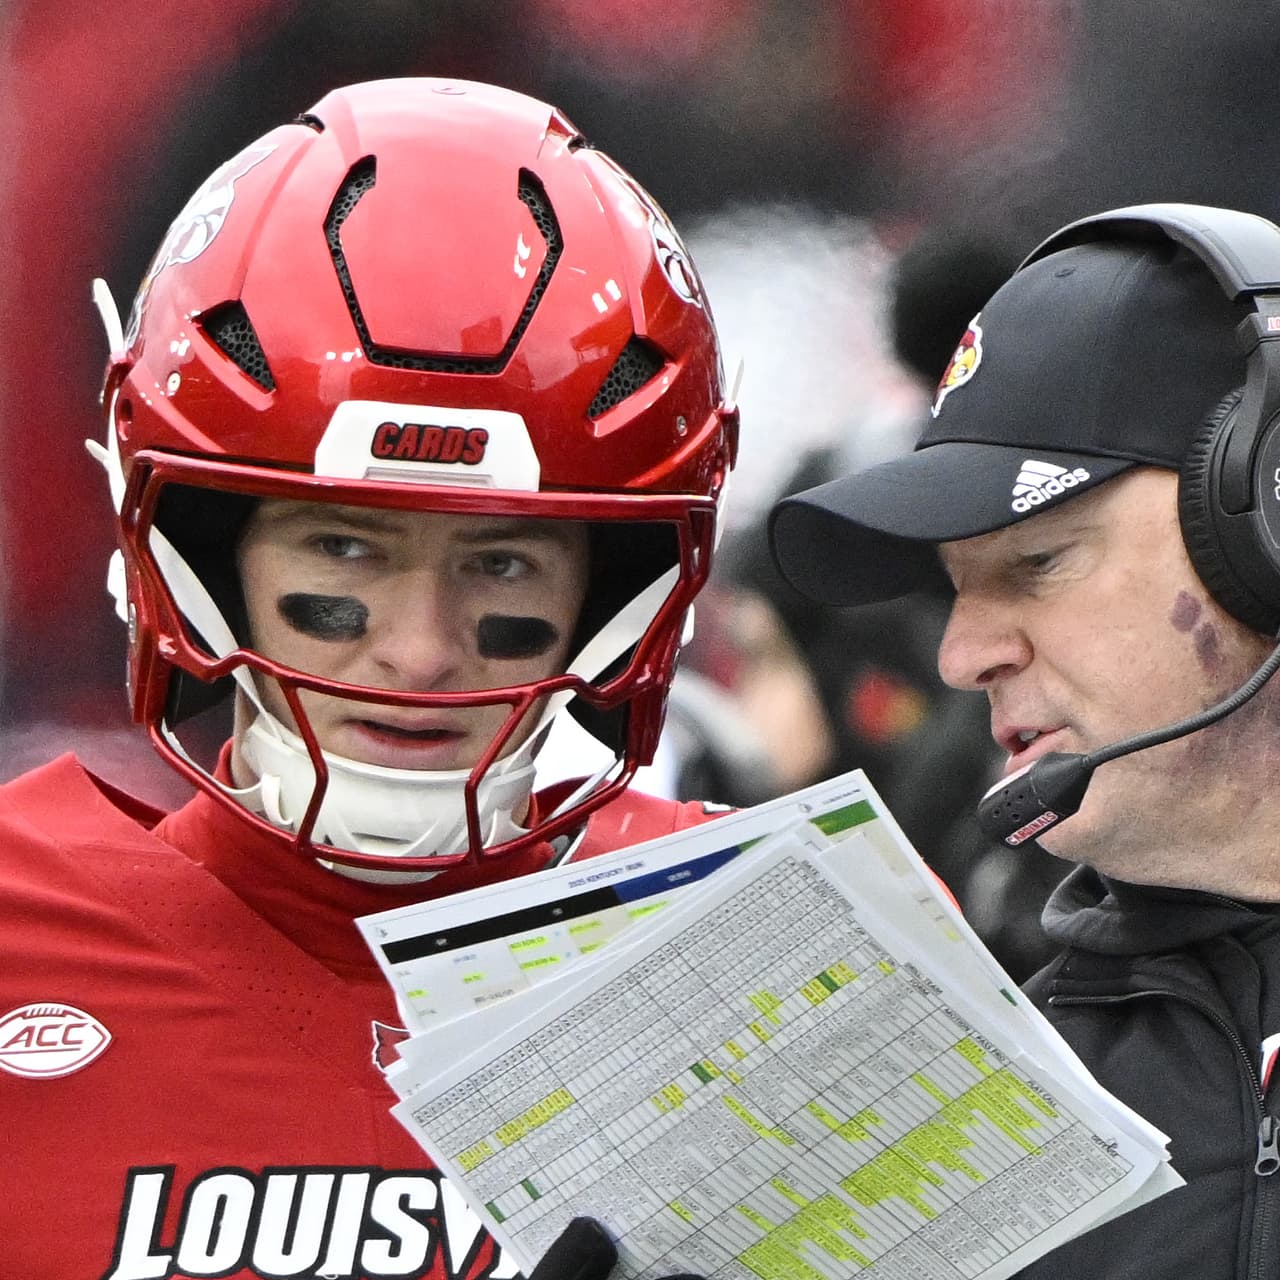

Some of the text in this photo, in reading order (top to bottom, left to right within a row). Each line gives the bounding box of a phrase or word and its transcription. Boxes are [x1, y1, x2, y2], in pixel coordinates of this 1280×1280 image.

[371, 421, 489, 465] CARDS
[1012, 466, 1090, 514] adidas
[1005, 811, 1058, 845] CARDINALS
[2, 1023, 89, 1049] ACC
